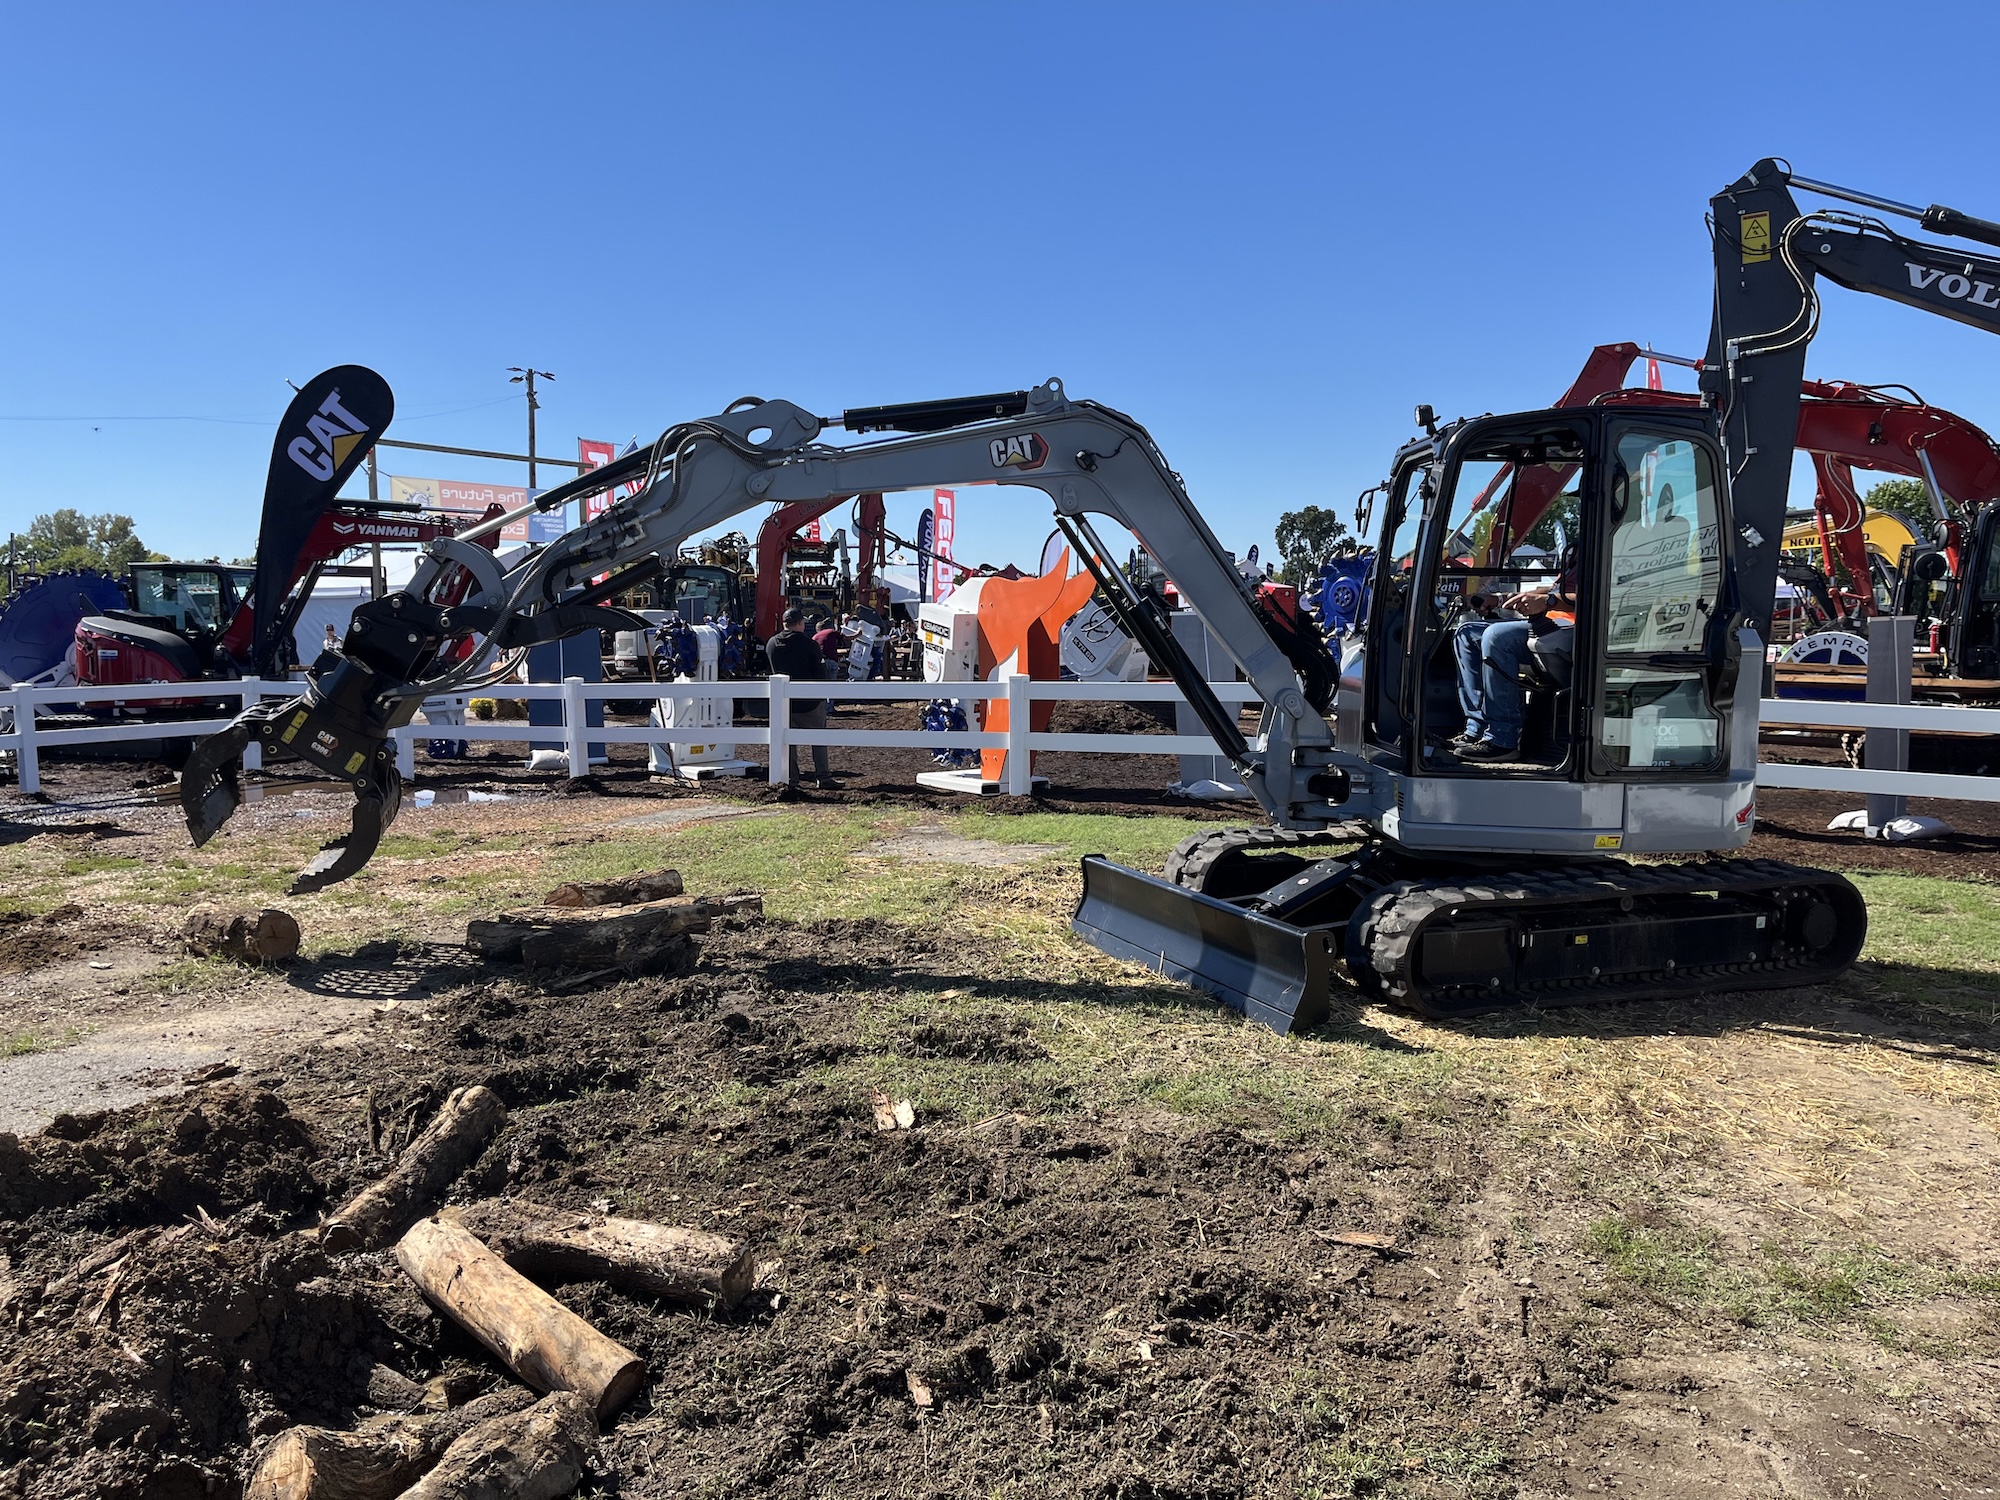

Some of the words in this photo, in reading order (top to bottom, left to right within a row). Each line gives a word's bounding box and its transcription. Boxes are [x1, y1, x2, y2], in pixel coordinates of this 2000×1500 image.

[1904, 262, 2000, 309] VOL
[287, 390, 370, 482] CAT
[990, 434, 1033, 467] CAT
[358, 524, 419, 537] YANMAR
[1790, 537, 1815, 546] NEW
[1792, 637, 1868, 658] KEMRO
[317, 730, 336, 745] CAT
